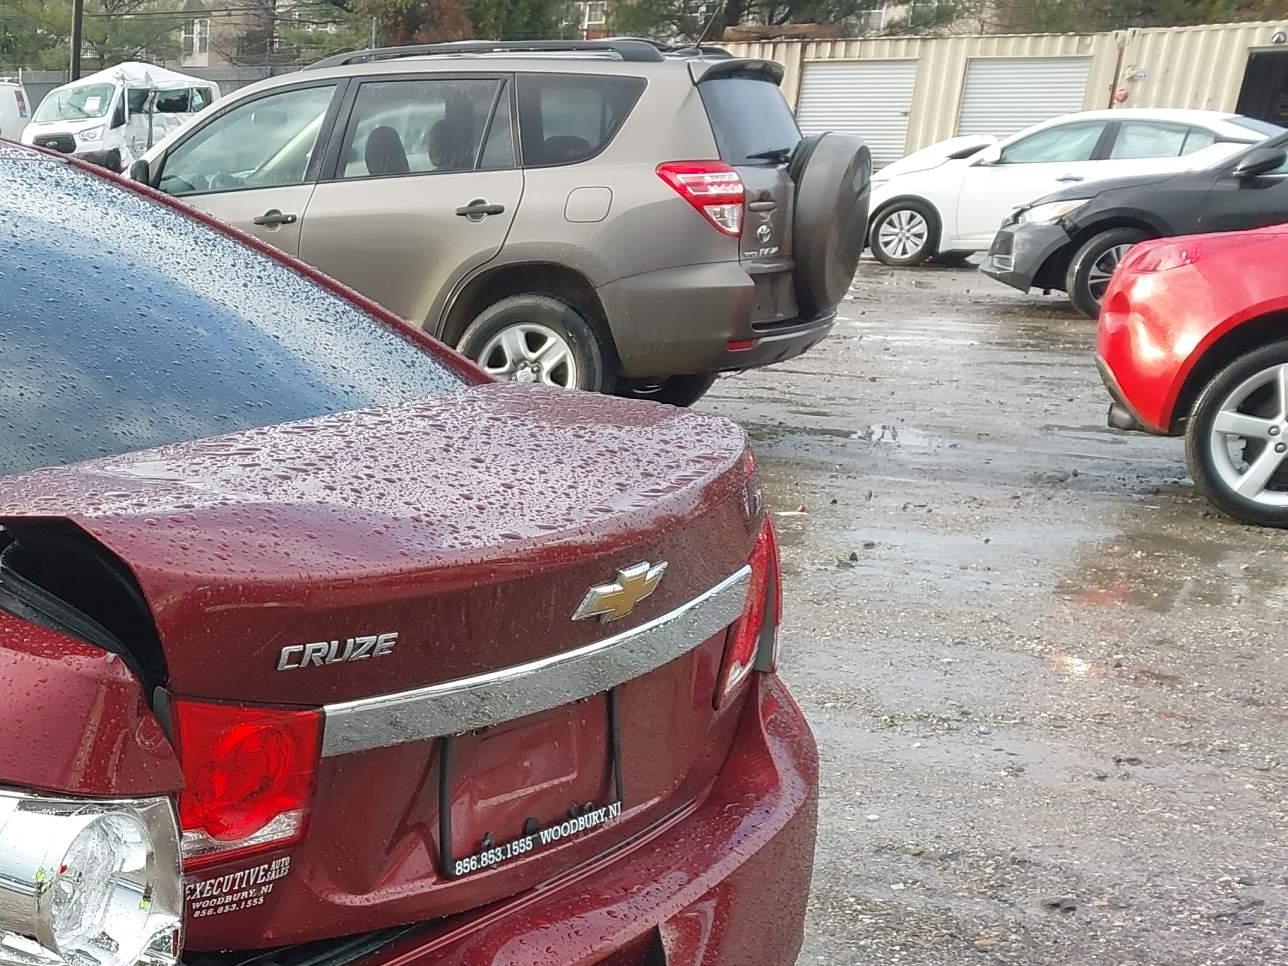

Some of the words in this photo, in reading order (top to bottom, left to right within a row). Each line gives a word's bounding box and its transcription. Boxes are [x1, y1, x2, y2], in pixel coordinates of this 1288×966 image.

[277, 632, 399, 671] CRUZE
[455, 836, 533, 876] 856.853.1555
[539, 807, 608, 845] WOODBURY,
[265, 865, 290, 882] SALES
[270, 856, 291, 871] AUTO
[185, 864, 269, 901] EXECUTIVE
[193, 896, 264, 918] 856.853.1555
